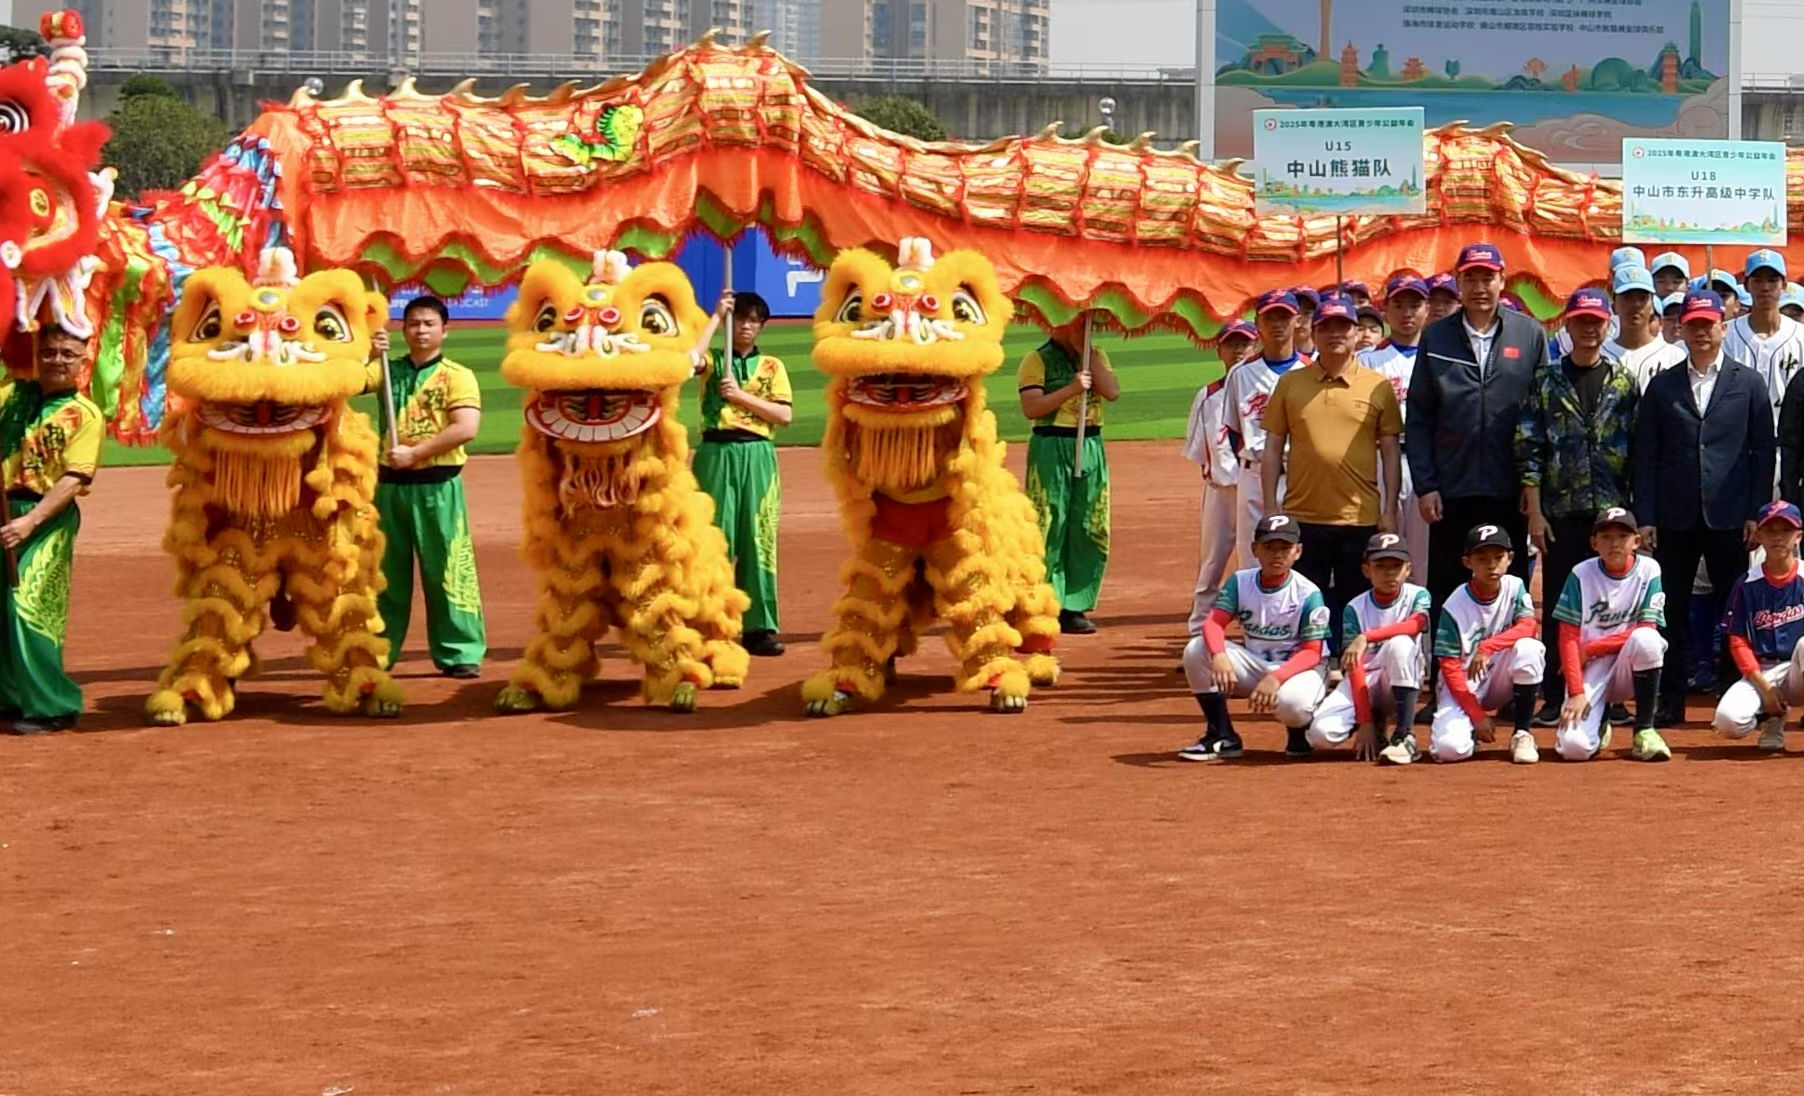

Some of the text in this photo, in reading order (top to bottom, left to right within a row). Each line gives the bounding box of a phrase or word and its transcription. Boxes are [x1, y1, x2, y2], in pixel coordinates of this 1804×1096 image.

[1325, 141, 1352, 151] U15
[1287, 158, 1392, 179] 中山熊猫队
[1691, 171, 1718, 181] U18
[1633, 185, 1776, 201] 中山市东升高级中学队
